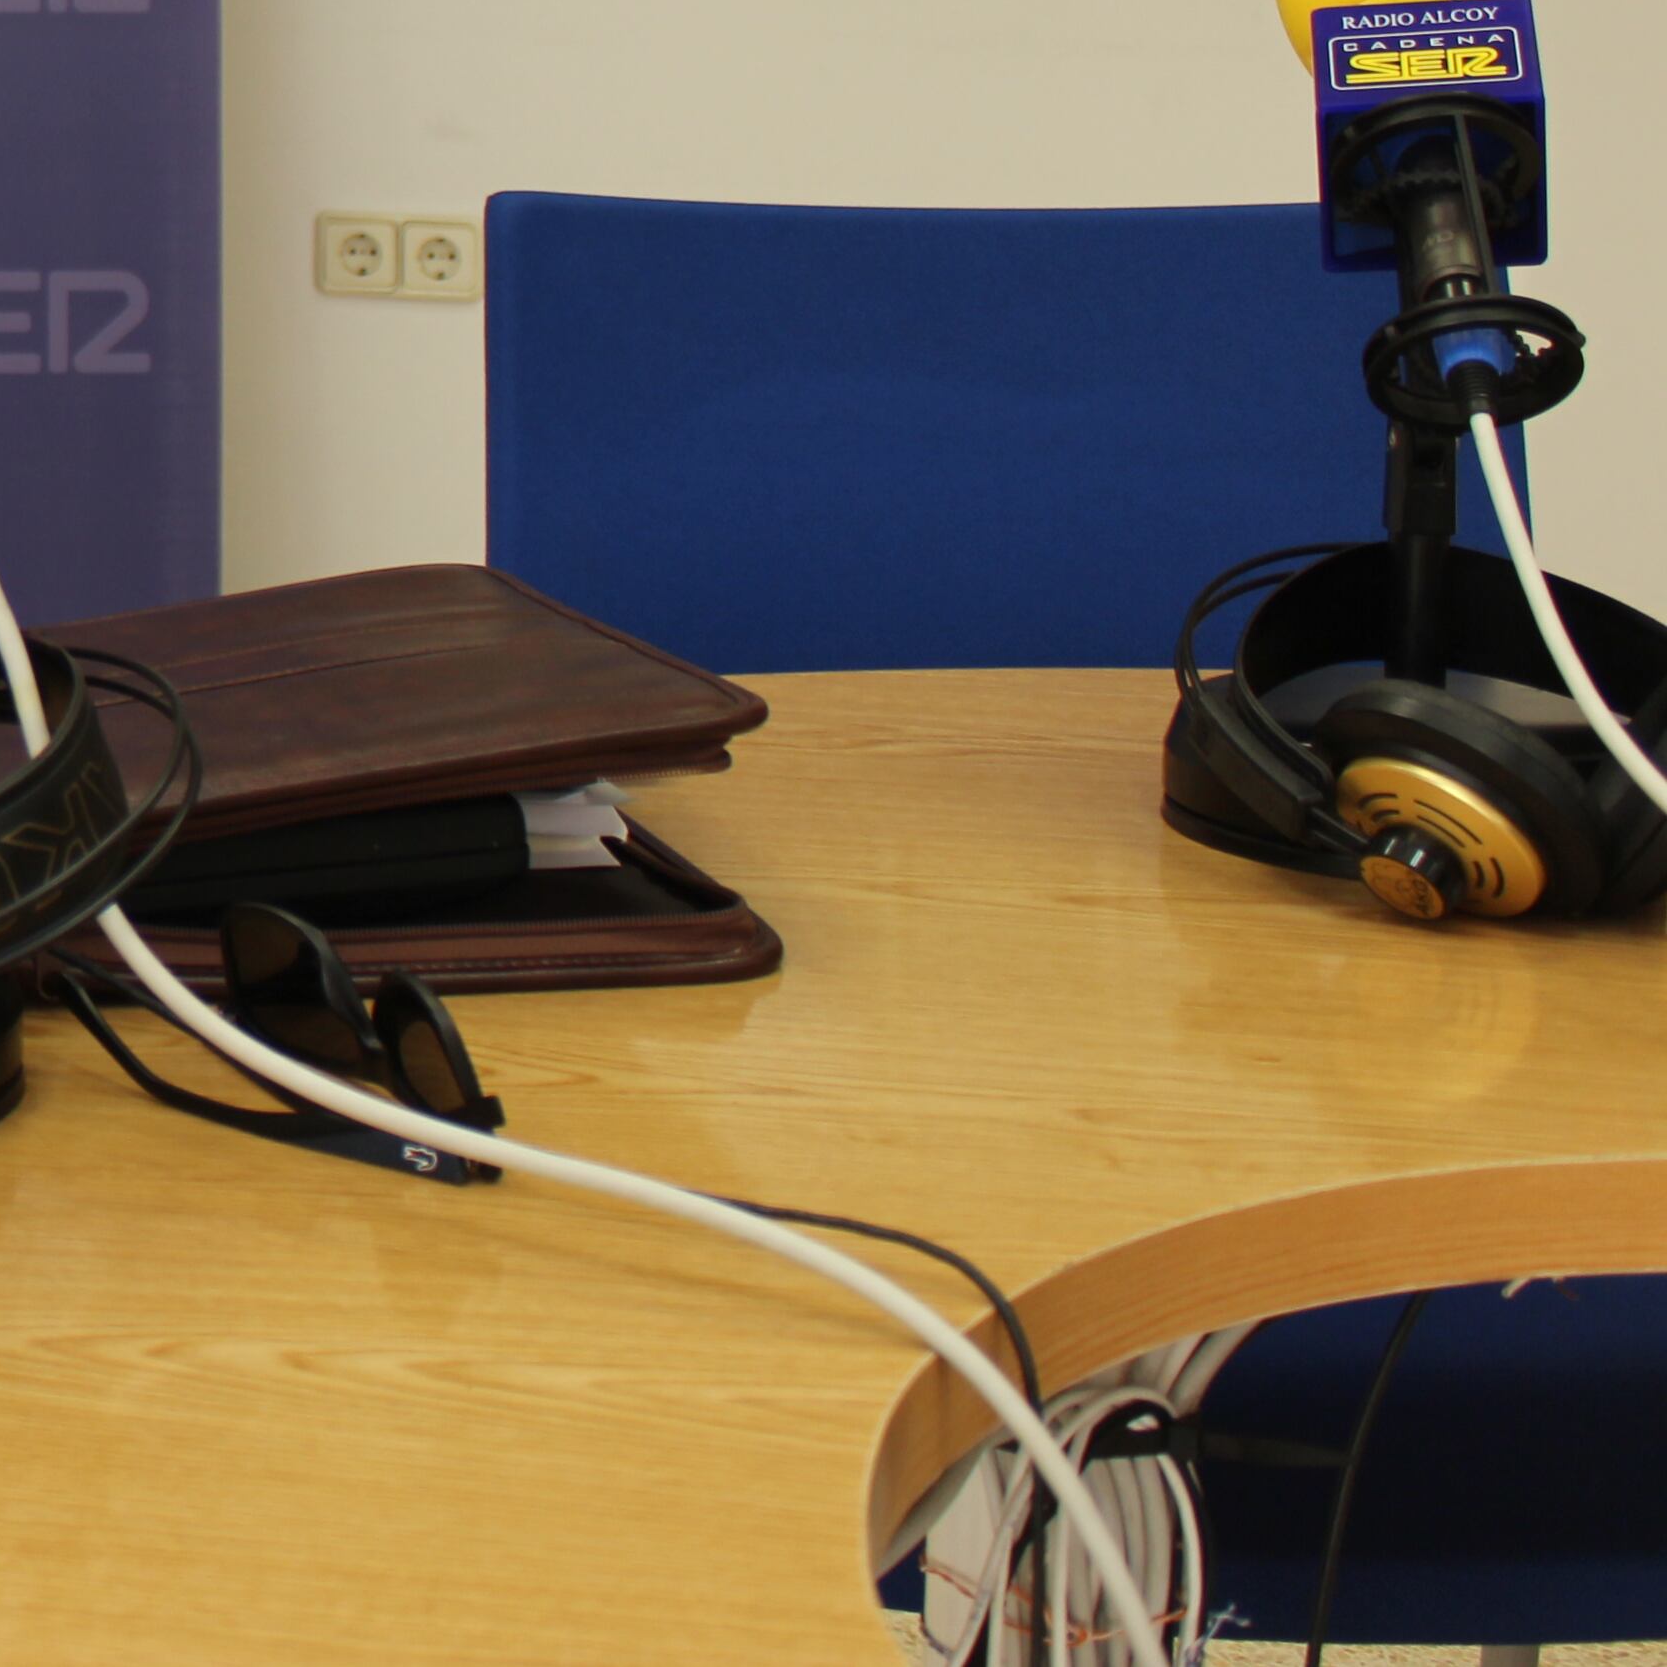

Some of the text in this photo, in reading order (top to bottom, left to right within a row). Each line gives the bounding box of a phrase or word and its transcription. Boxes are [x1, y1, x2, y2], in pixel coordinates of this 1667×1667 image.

[1342, 7, 1498, 30] RADIO ALCOY
[1343, 34, 1505, 52] CADENA
[1345, 46, 1507, 84] SER
